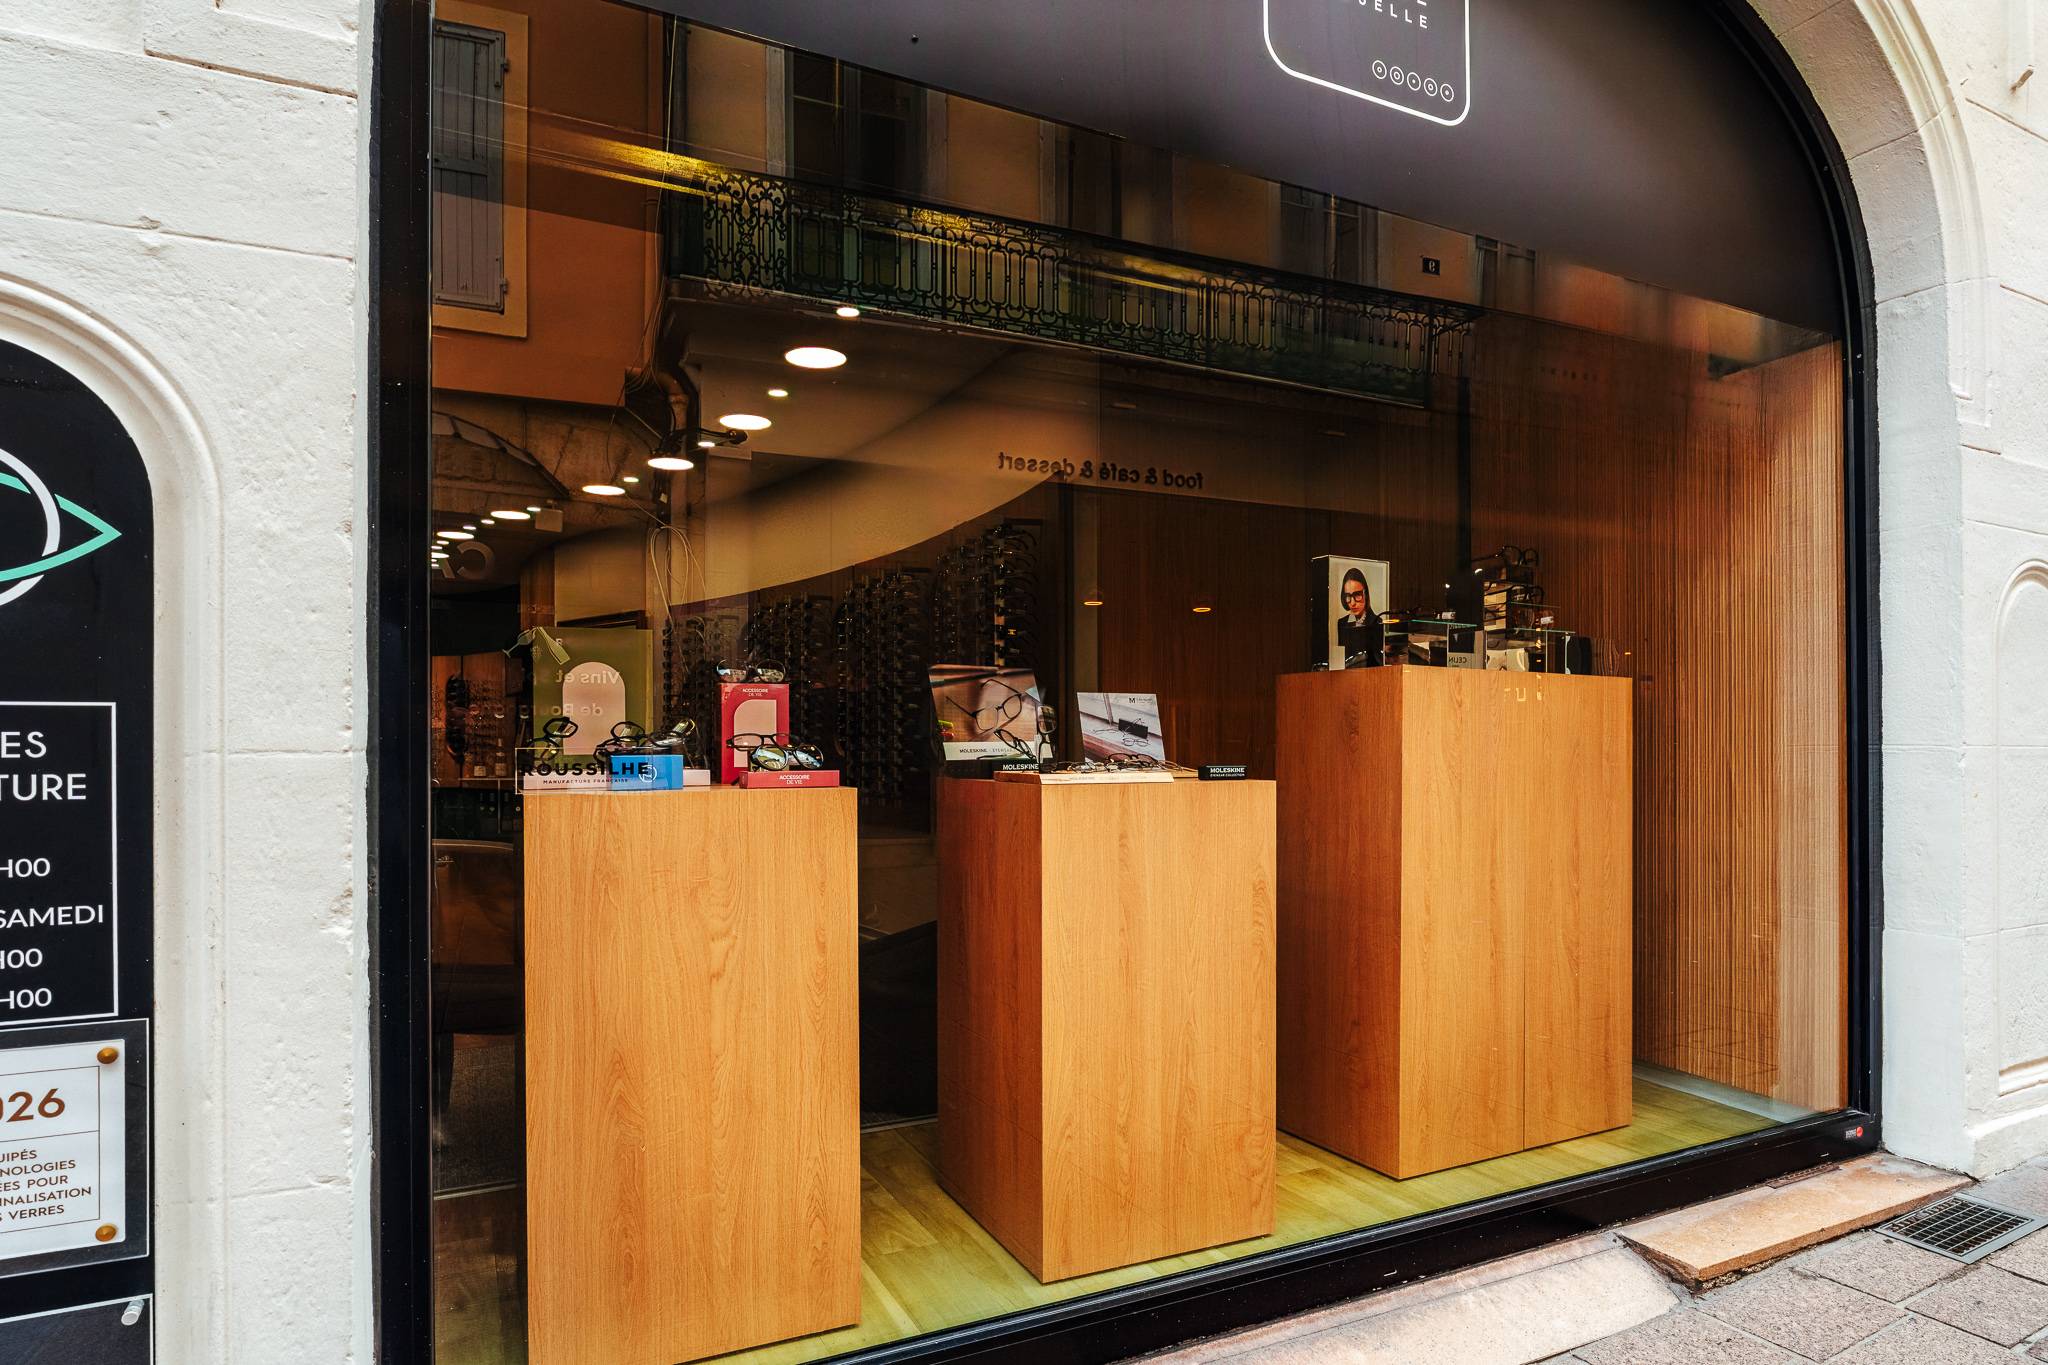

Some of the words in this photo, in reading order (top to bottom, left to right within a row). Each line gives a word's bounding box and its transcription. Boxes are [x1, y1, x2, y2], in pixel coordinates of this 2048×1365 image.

[1, 731, 47, 759] ES
[0, 773, 87, 801] TURE
[0, 1088, 65, 1123] 26
[27, 1175, 69, 1189] POUR
[0, 1186, 92, 1207] NALISATION
[8, 1204, 65, 1221] VERRES
